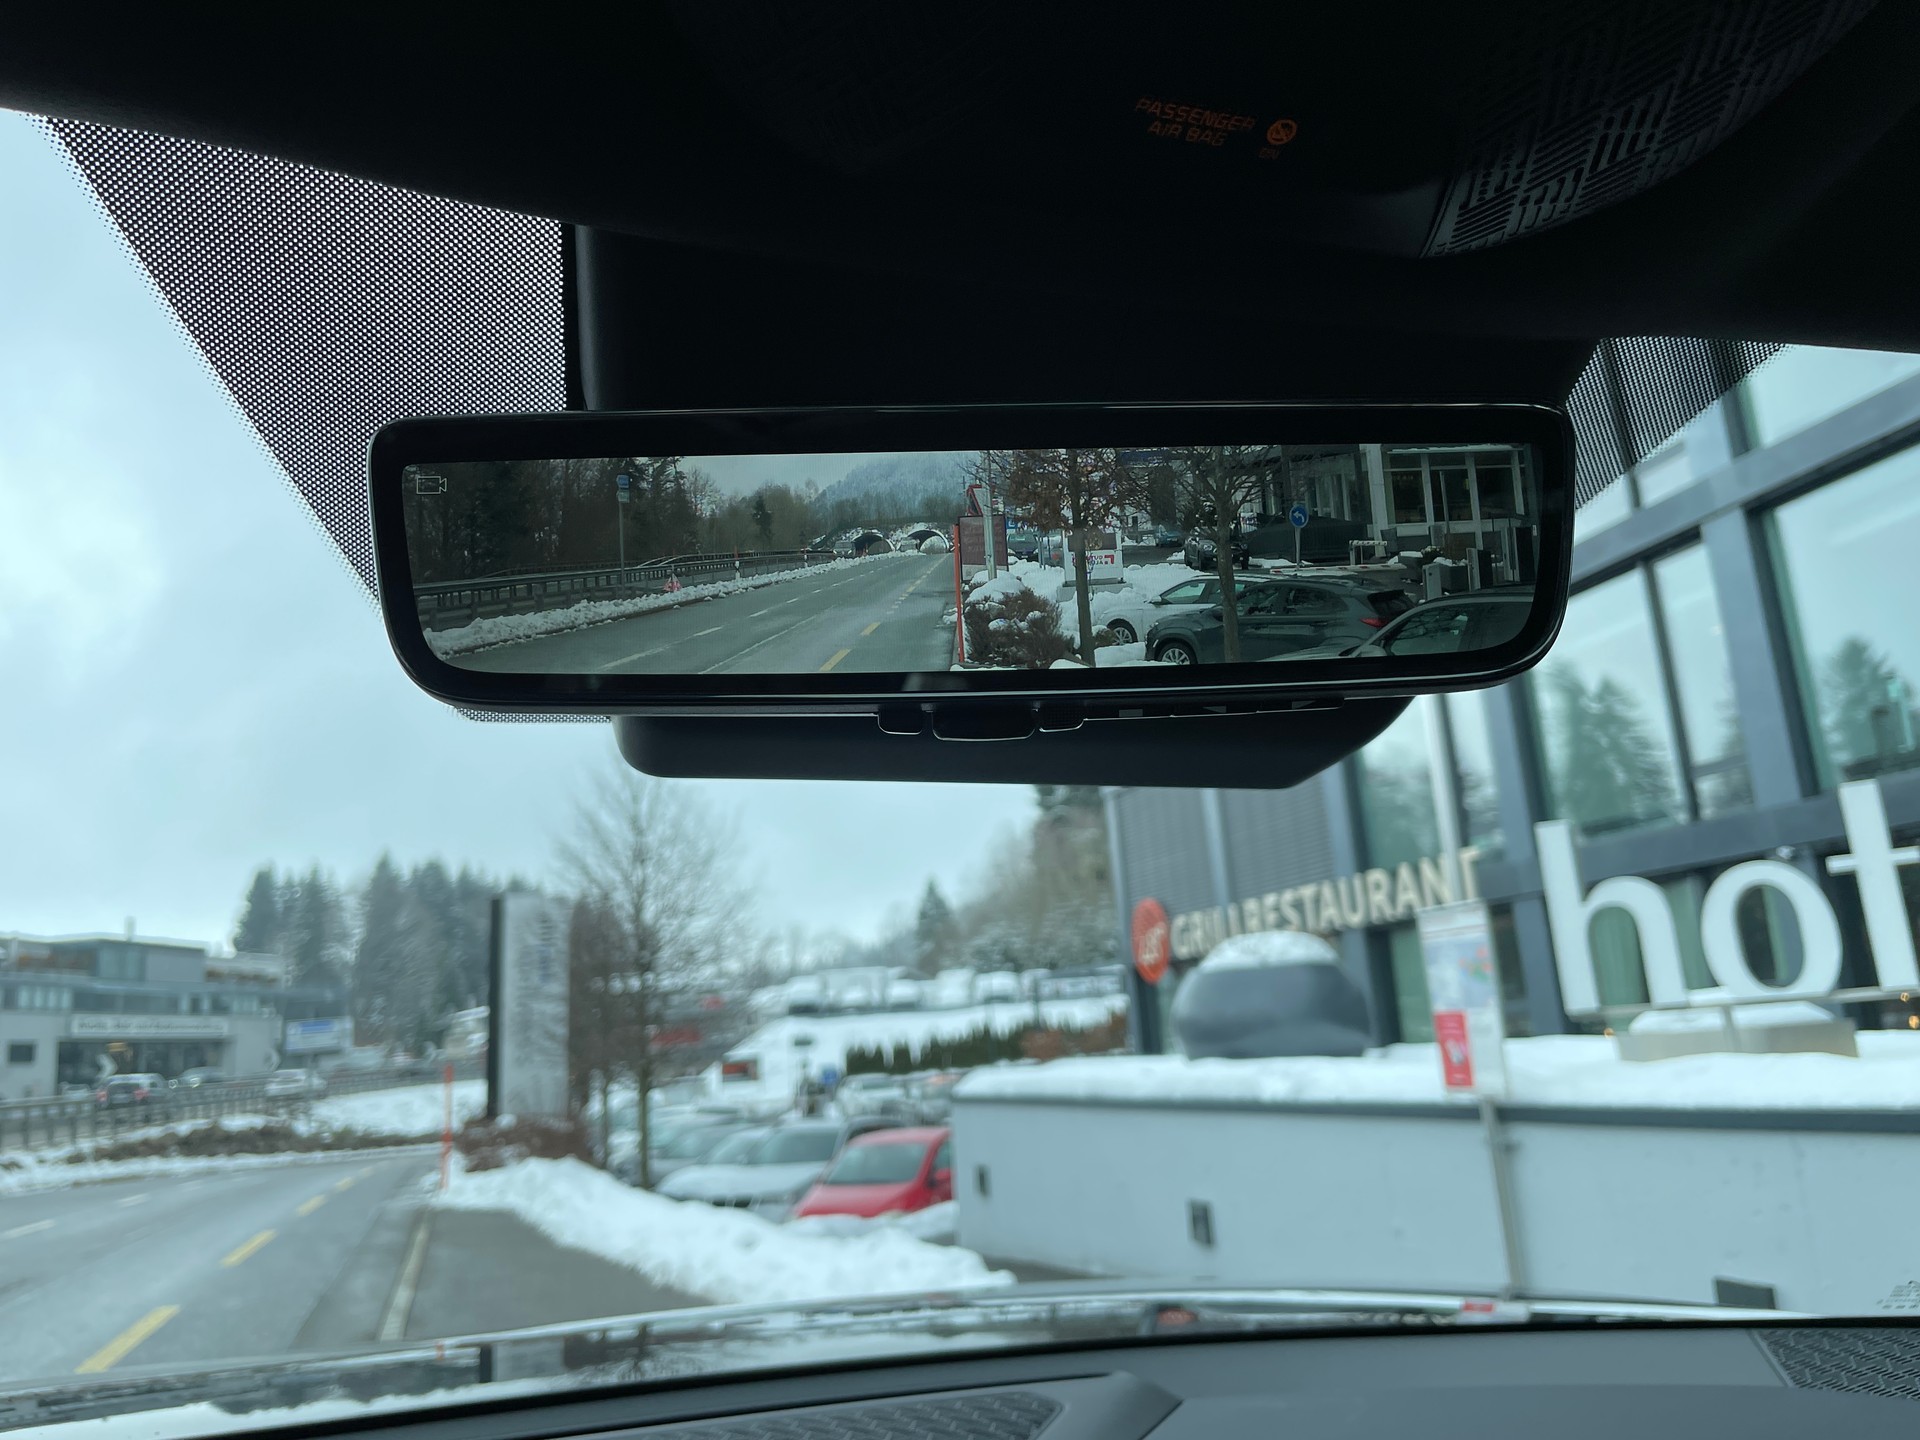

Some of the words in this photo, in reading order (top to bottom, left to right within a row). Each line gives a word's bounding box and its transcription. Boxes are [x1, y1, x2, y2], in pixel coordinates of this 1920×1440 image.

[1136, 97, 1256, 131] PASSENGER
[1147, 120, 1182, 139] AIR
[1185, 127, 1229, 146] BAG
